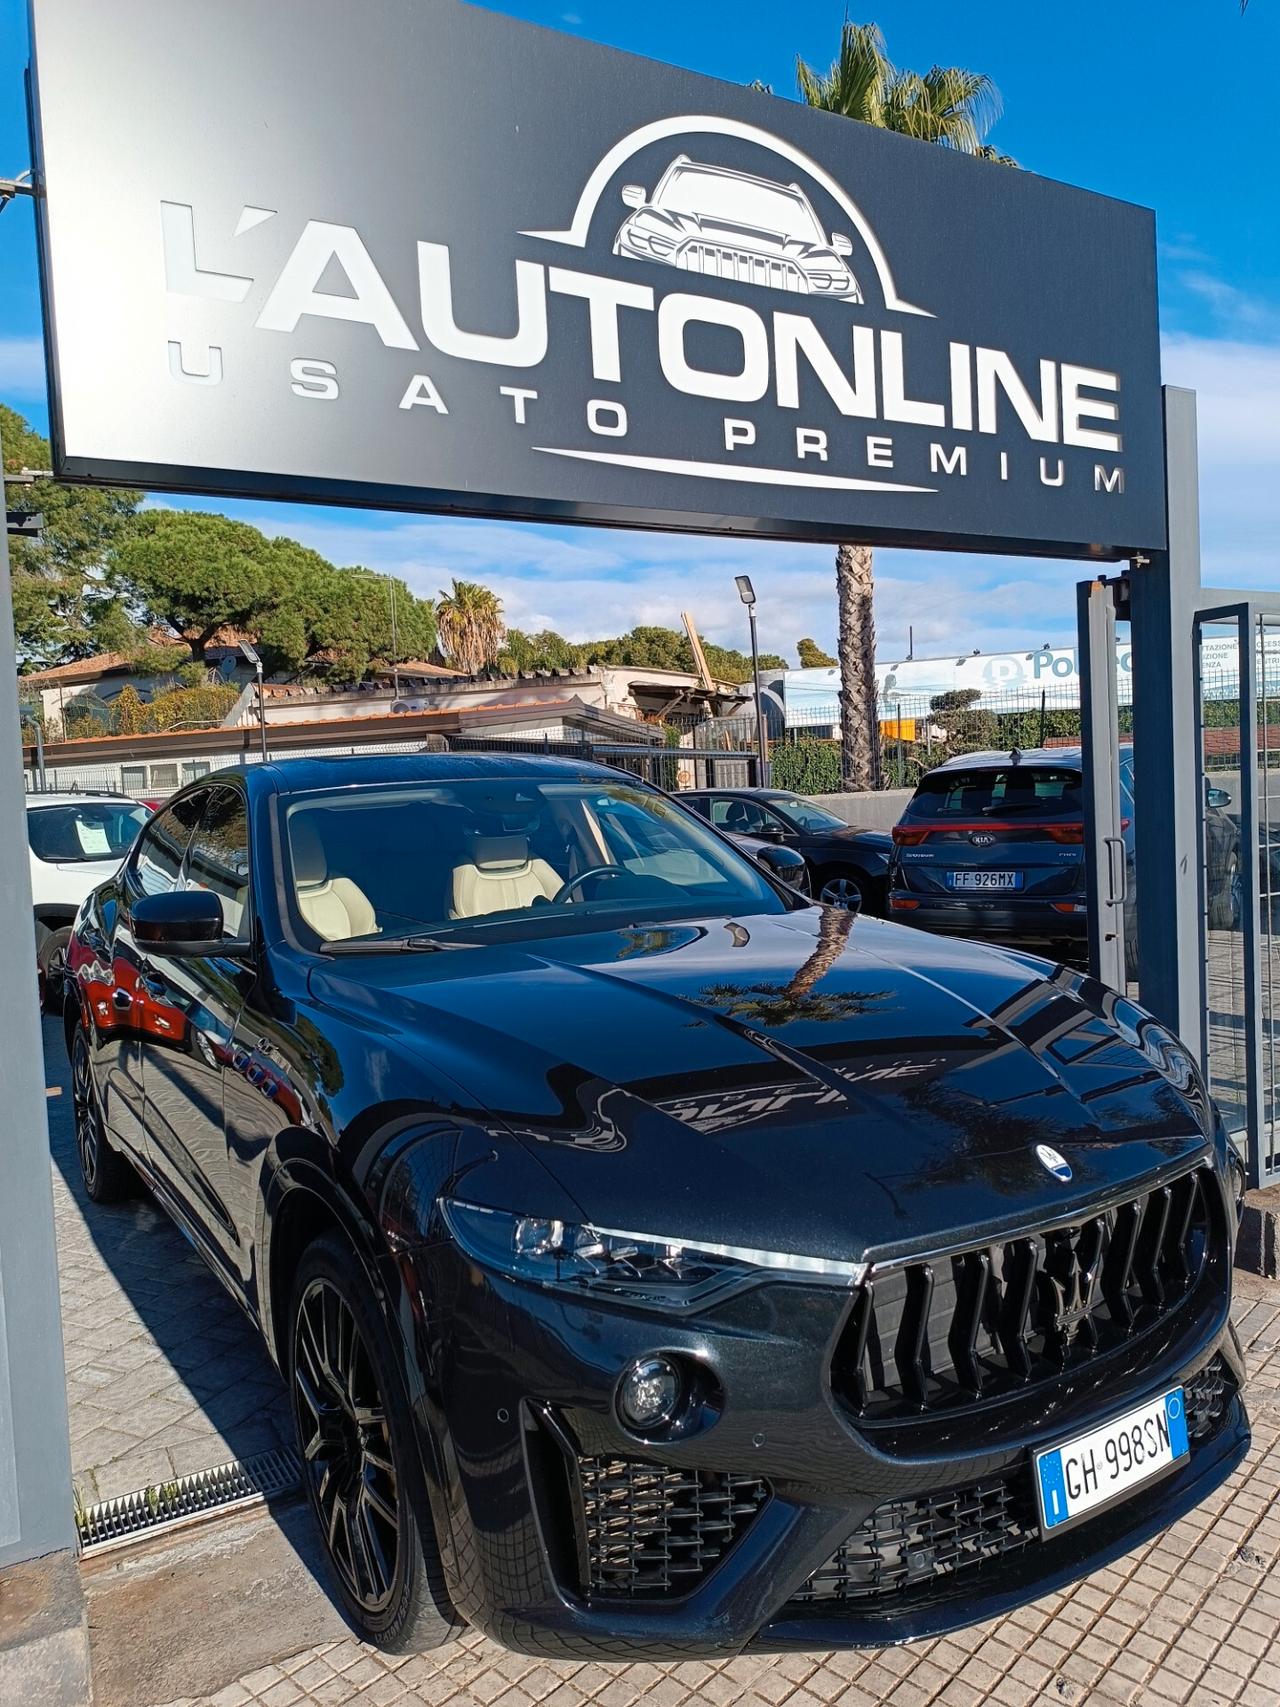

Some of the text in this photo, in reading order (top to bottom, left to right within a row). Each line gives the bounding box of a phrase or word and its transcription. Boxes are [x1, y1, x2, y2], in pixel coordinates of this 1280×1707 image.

[160, 199, 1122, 453] L'AUTONLINE
[168, 339, 1125, 494] USATO PREMIUM
[955, 872, 1014, 887] FF 926MX
[975, 836, 989, 844] KIA
[1065, 1409, 1170, 1500] GH 998SN
